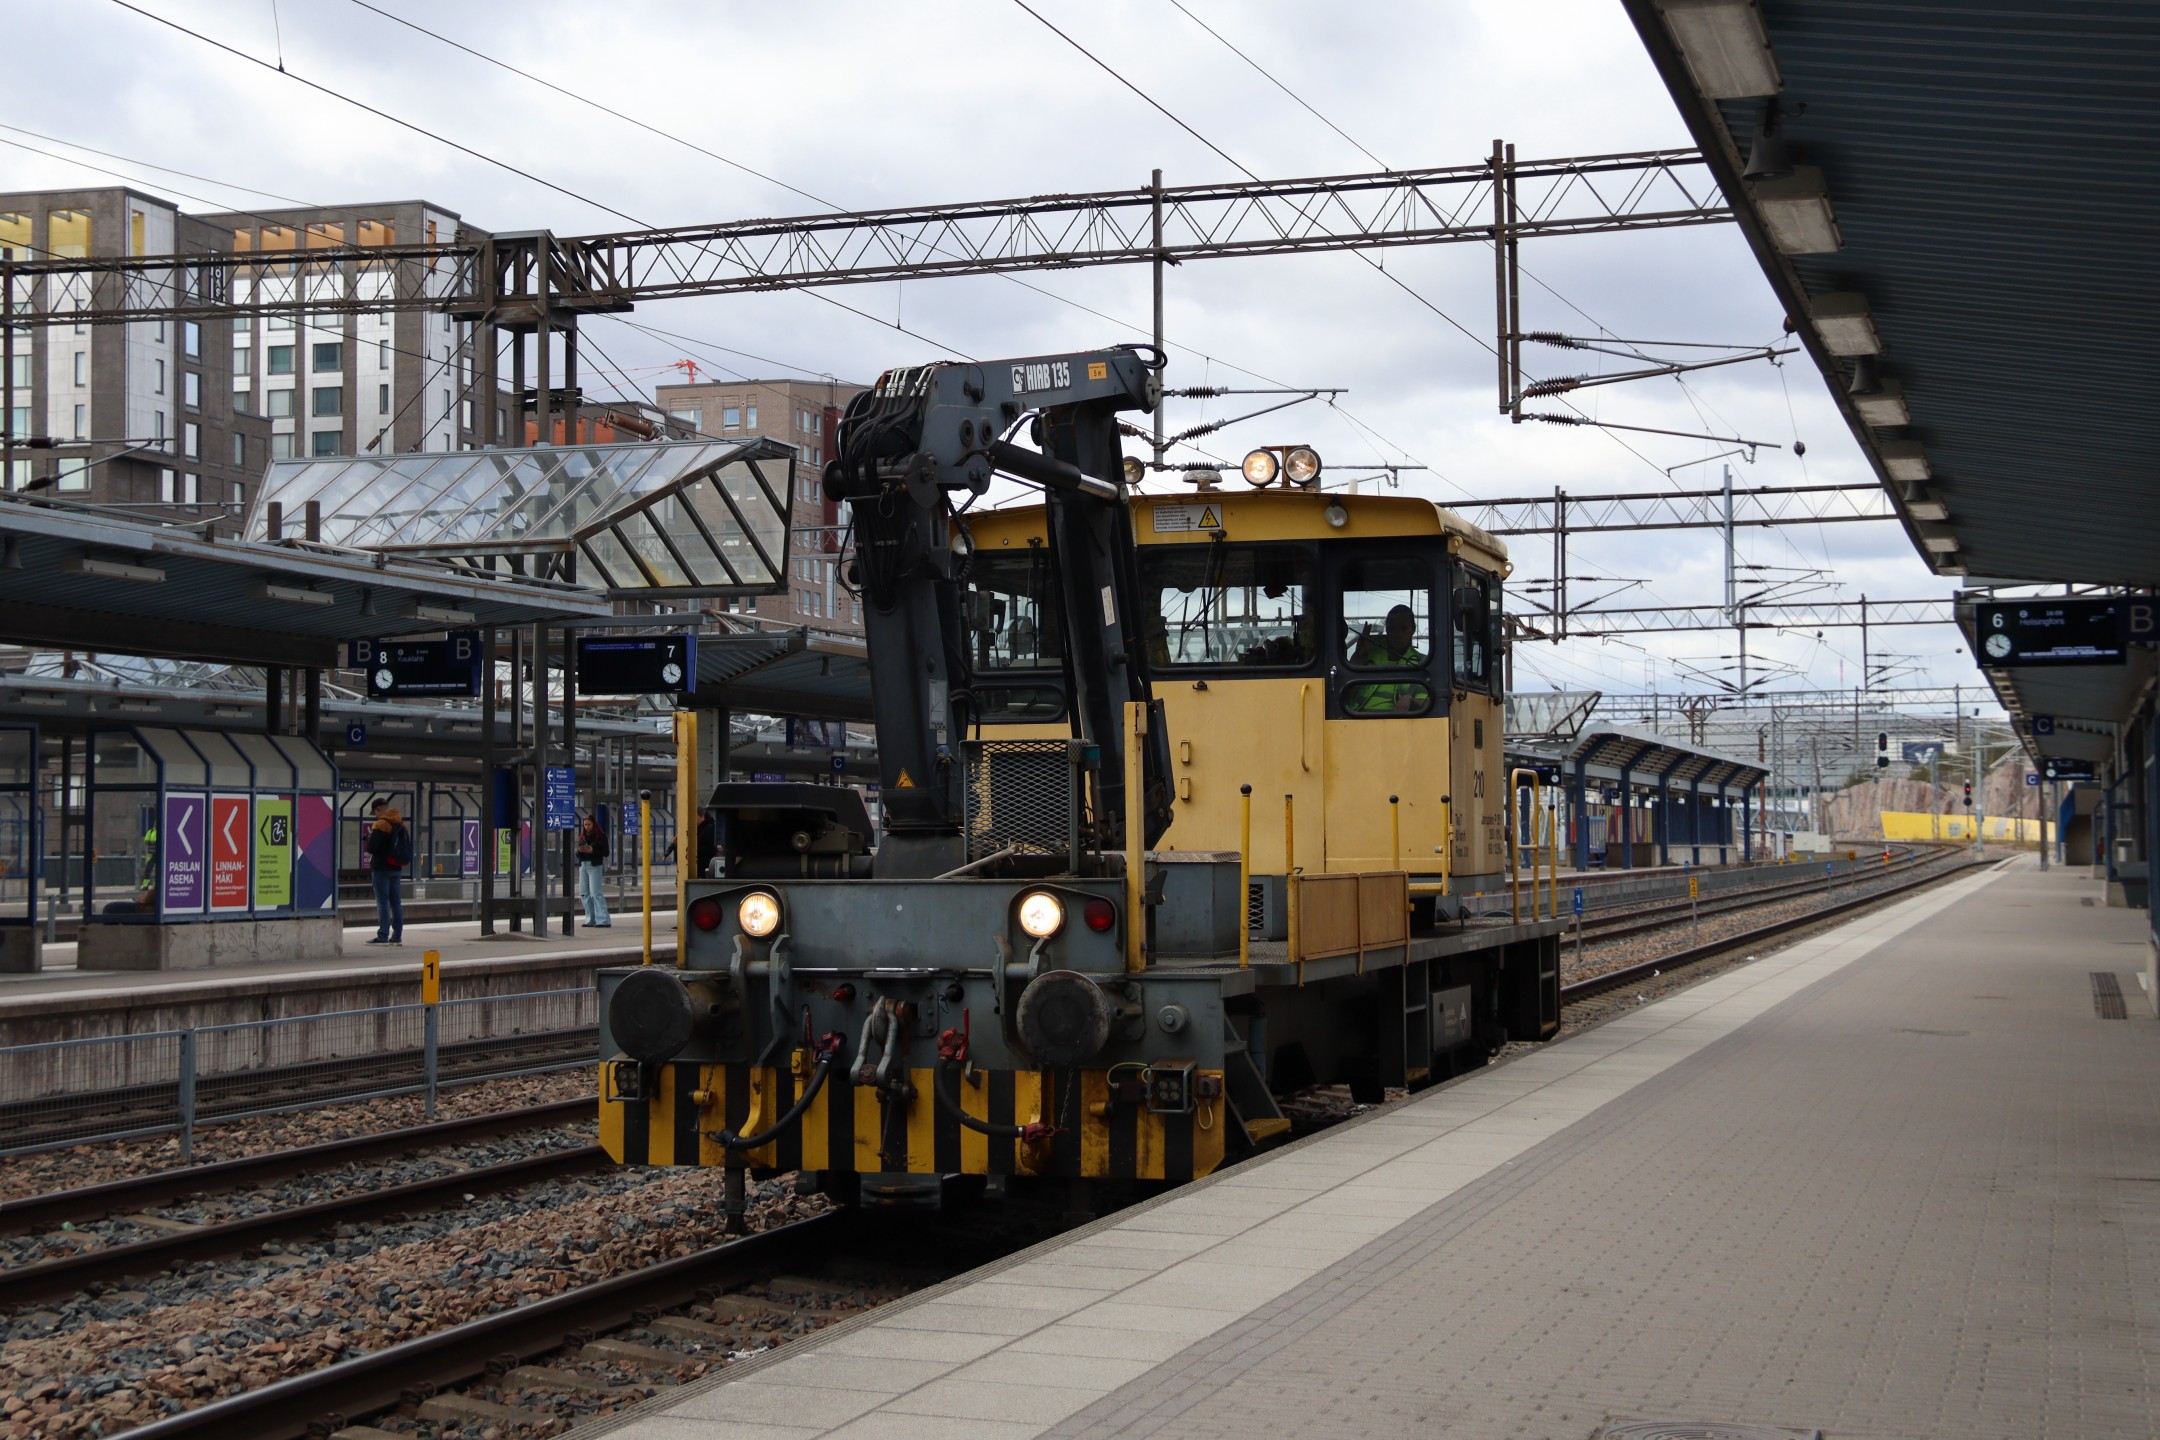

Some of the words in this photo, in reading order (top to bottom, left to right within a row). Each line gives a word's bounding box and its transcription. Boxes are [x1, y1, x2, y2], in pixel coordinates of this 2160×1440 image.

[1025, 363, 1051, 391] HIAB
[1051, 361, 1071, 388] 135
[1992, 613, 2003, 628] 6
[2019, 618, 2065, 627] Helsingfors
[2130, 605, 2154, 633] B
[357, 641, 372, 662] B
[456, 638, 471, 660] B
[667, 645, 675, 658] 7
[379, 651, 388, 664] 8
[2037, 719, 2050, 732] C
[351, 728, 361, 742] C
[833, 758, 842, 769] C
[1474, 770, 1485, 798] 210
[2028, 775, 2037, 784] C
[1611, 789, 1618, 798] C
[169, 861, 201, 872] PASILAN
[215, 861, 245, 871] LINNAN-
[168, 874, 194, 884] ASEMA
[215, 871, 233, 884] MÄKI
[1575, 894, 1581, 904] 1
[426, 962, 434, 980] 1
